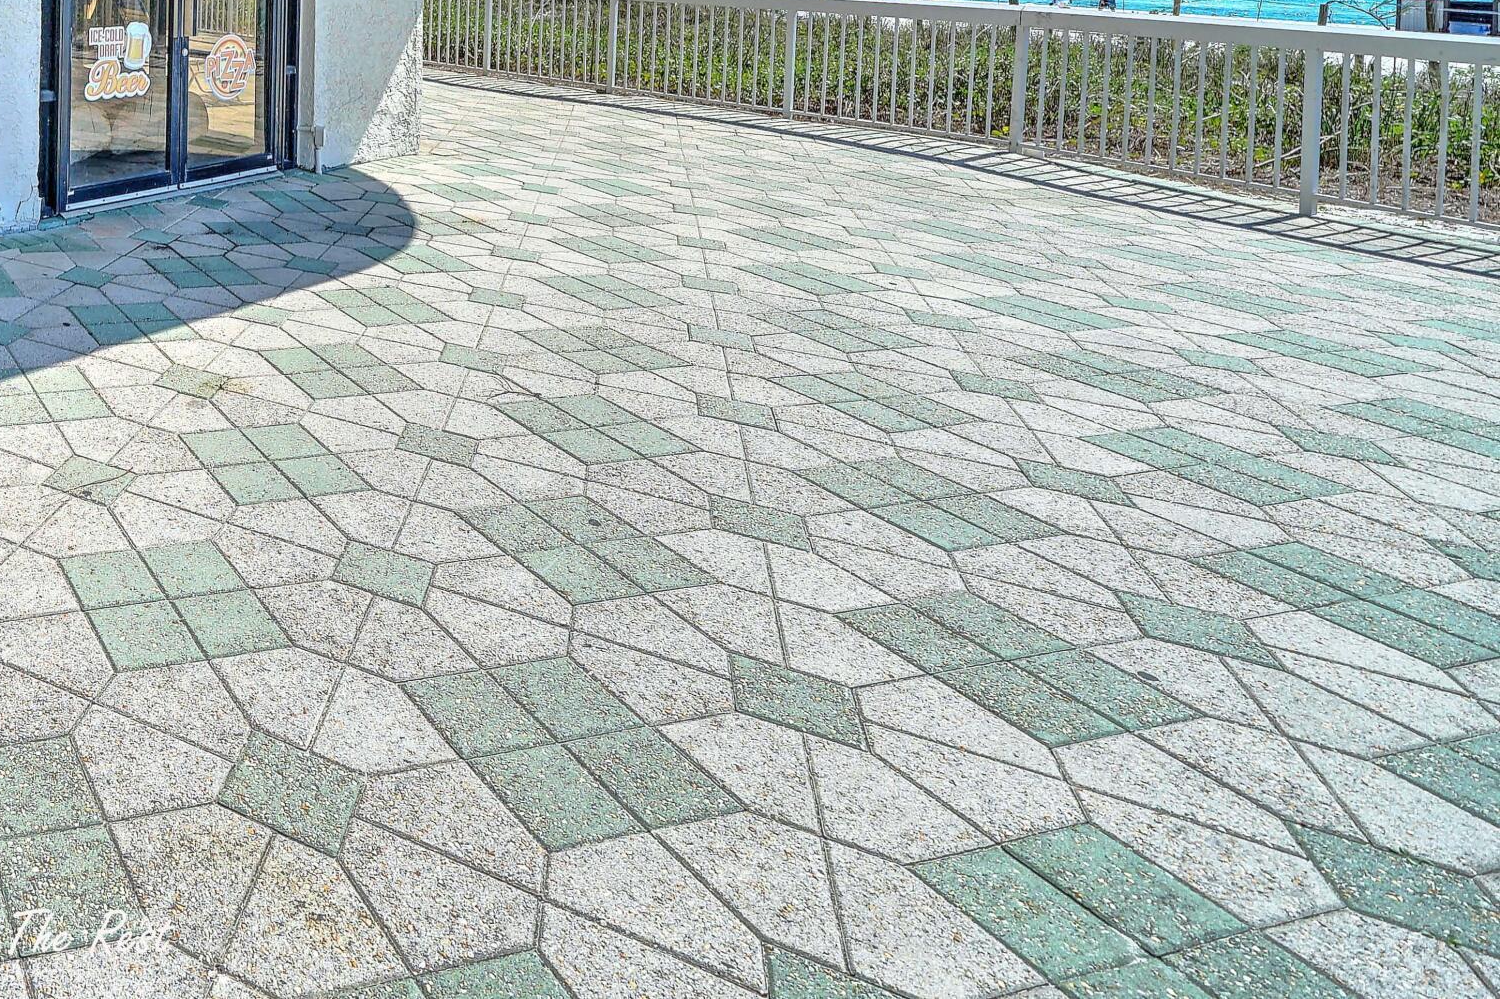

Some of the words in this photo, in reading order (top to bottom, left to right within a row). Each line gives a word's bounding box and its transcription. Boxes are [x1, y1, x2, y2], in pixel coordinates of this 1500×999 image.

[90, 28, 124, 43] ICE-COLD
[99, 43, 125, 59] DRAFT
[86, 59, 148, 97] Beer
[206, 49, 256, 90] PIZZA
